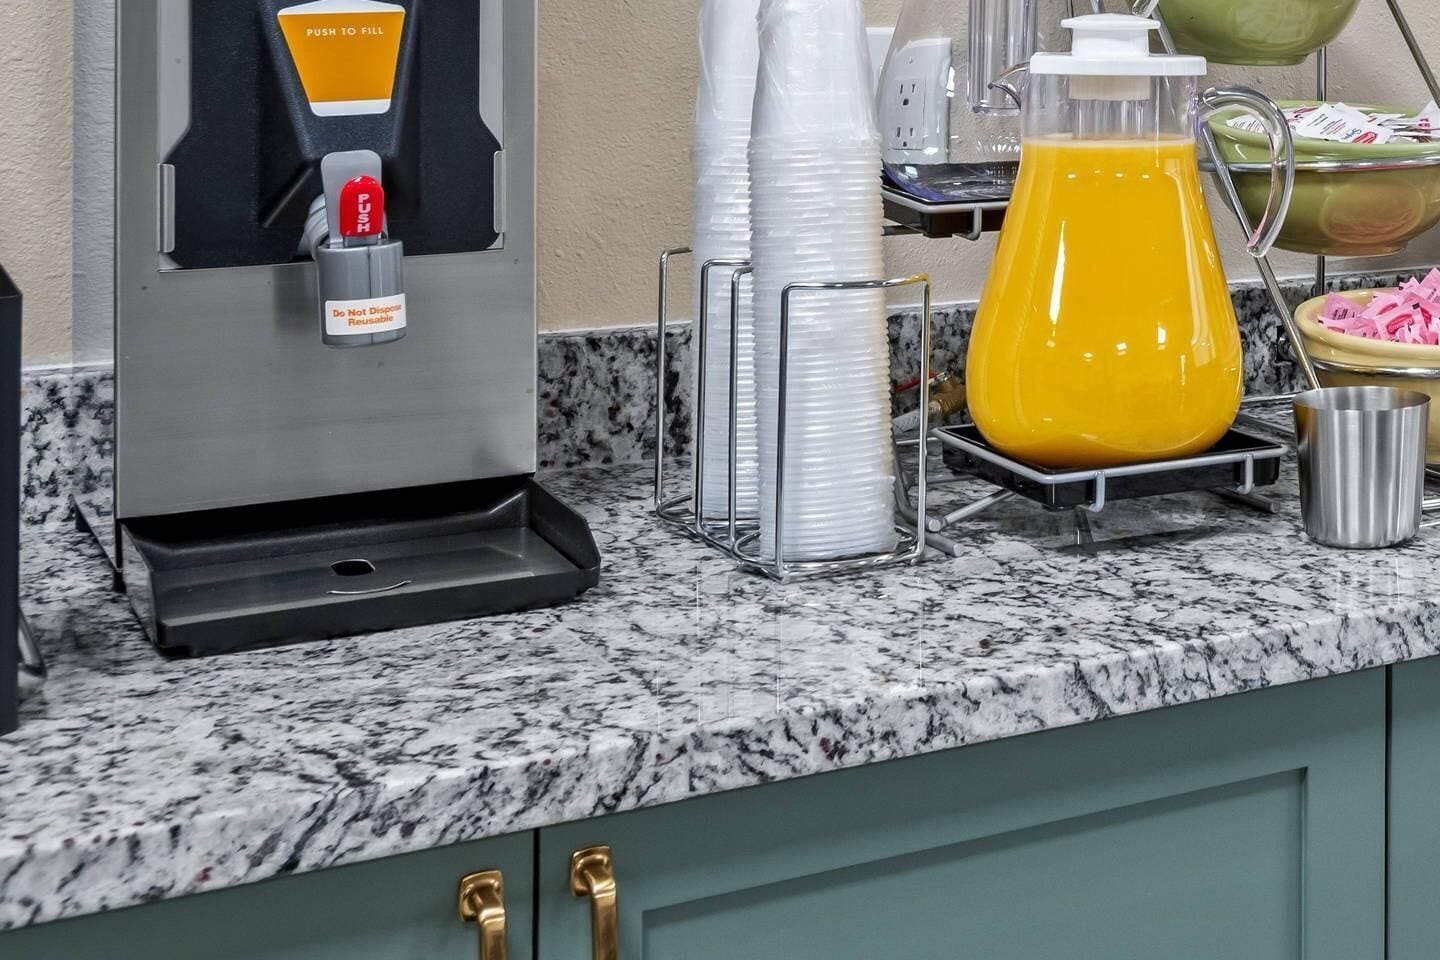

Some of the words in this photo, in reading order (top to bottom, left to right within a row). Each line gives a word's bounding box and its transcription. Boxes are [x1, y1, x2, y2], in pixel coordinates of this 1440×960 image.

[306, 28, 336, 37] PUSH
[341, 27, 356, 36] TO
[361, 26, 383, 35] FILL
[357, 193, 372, 233] PUSH
[333, 309, 345, 317] Do
[348, 307, 366, 317] Not
[369, 303, 402, 316] Dispose
[348, 314, 394, 326] Reusable
